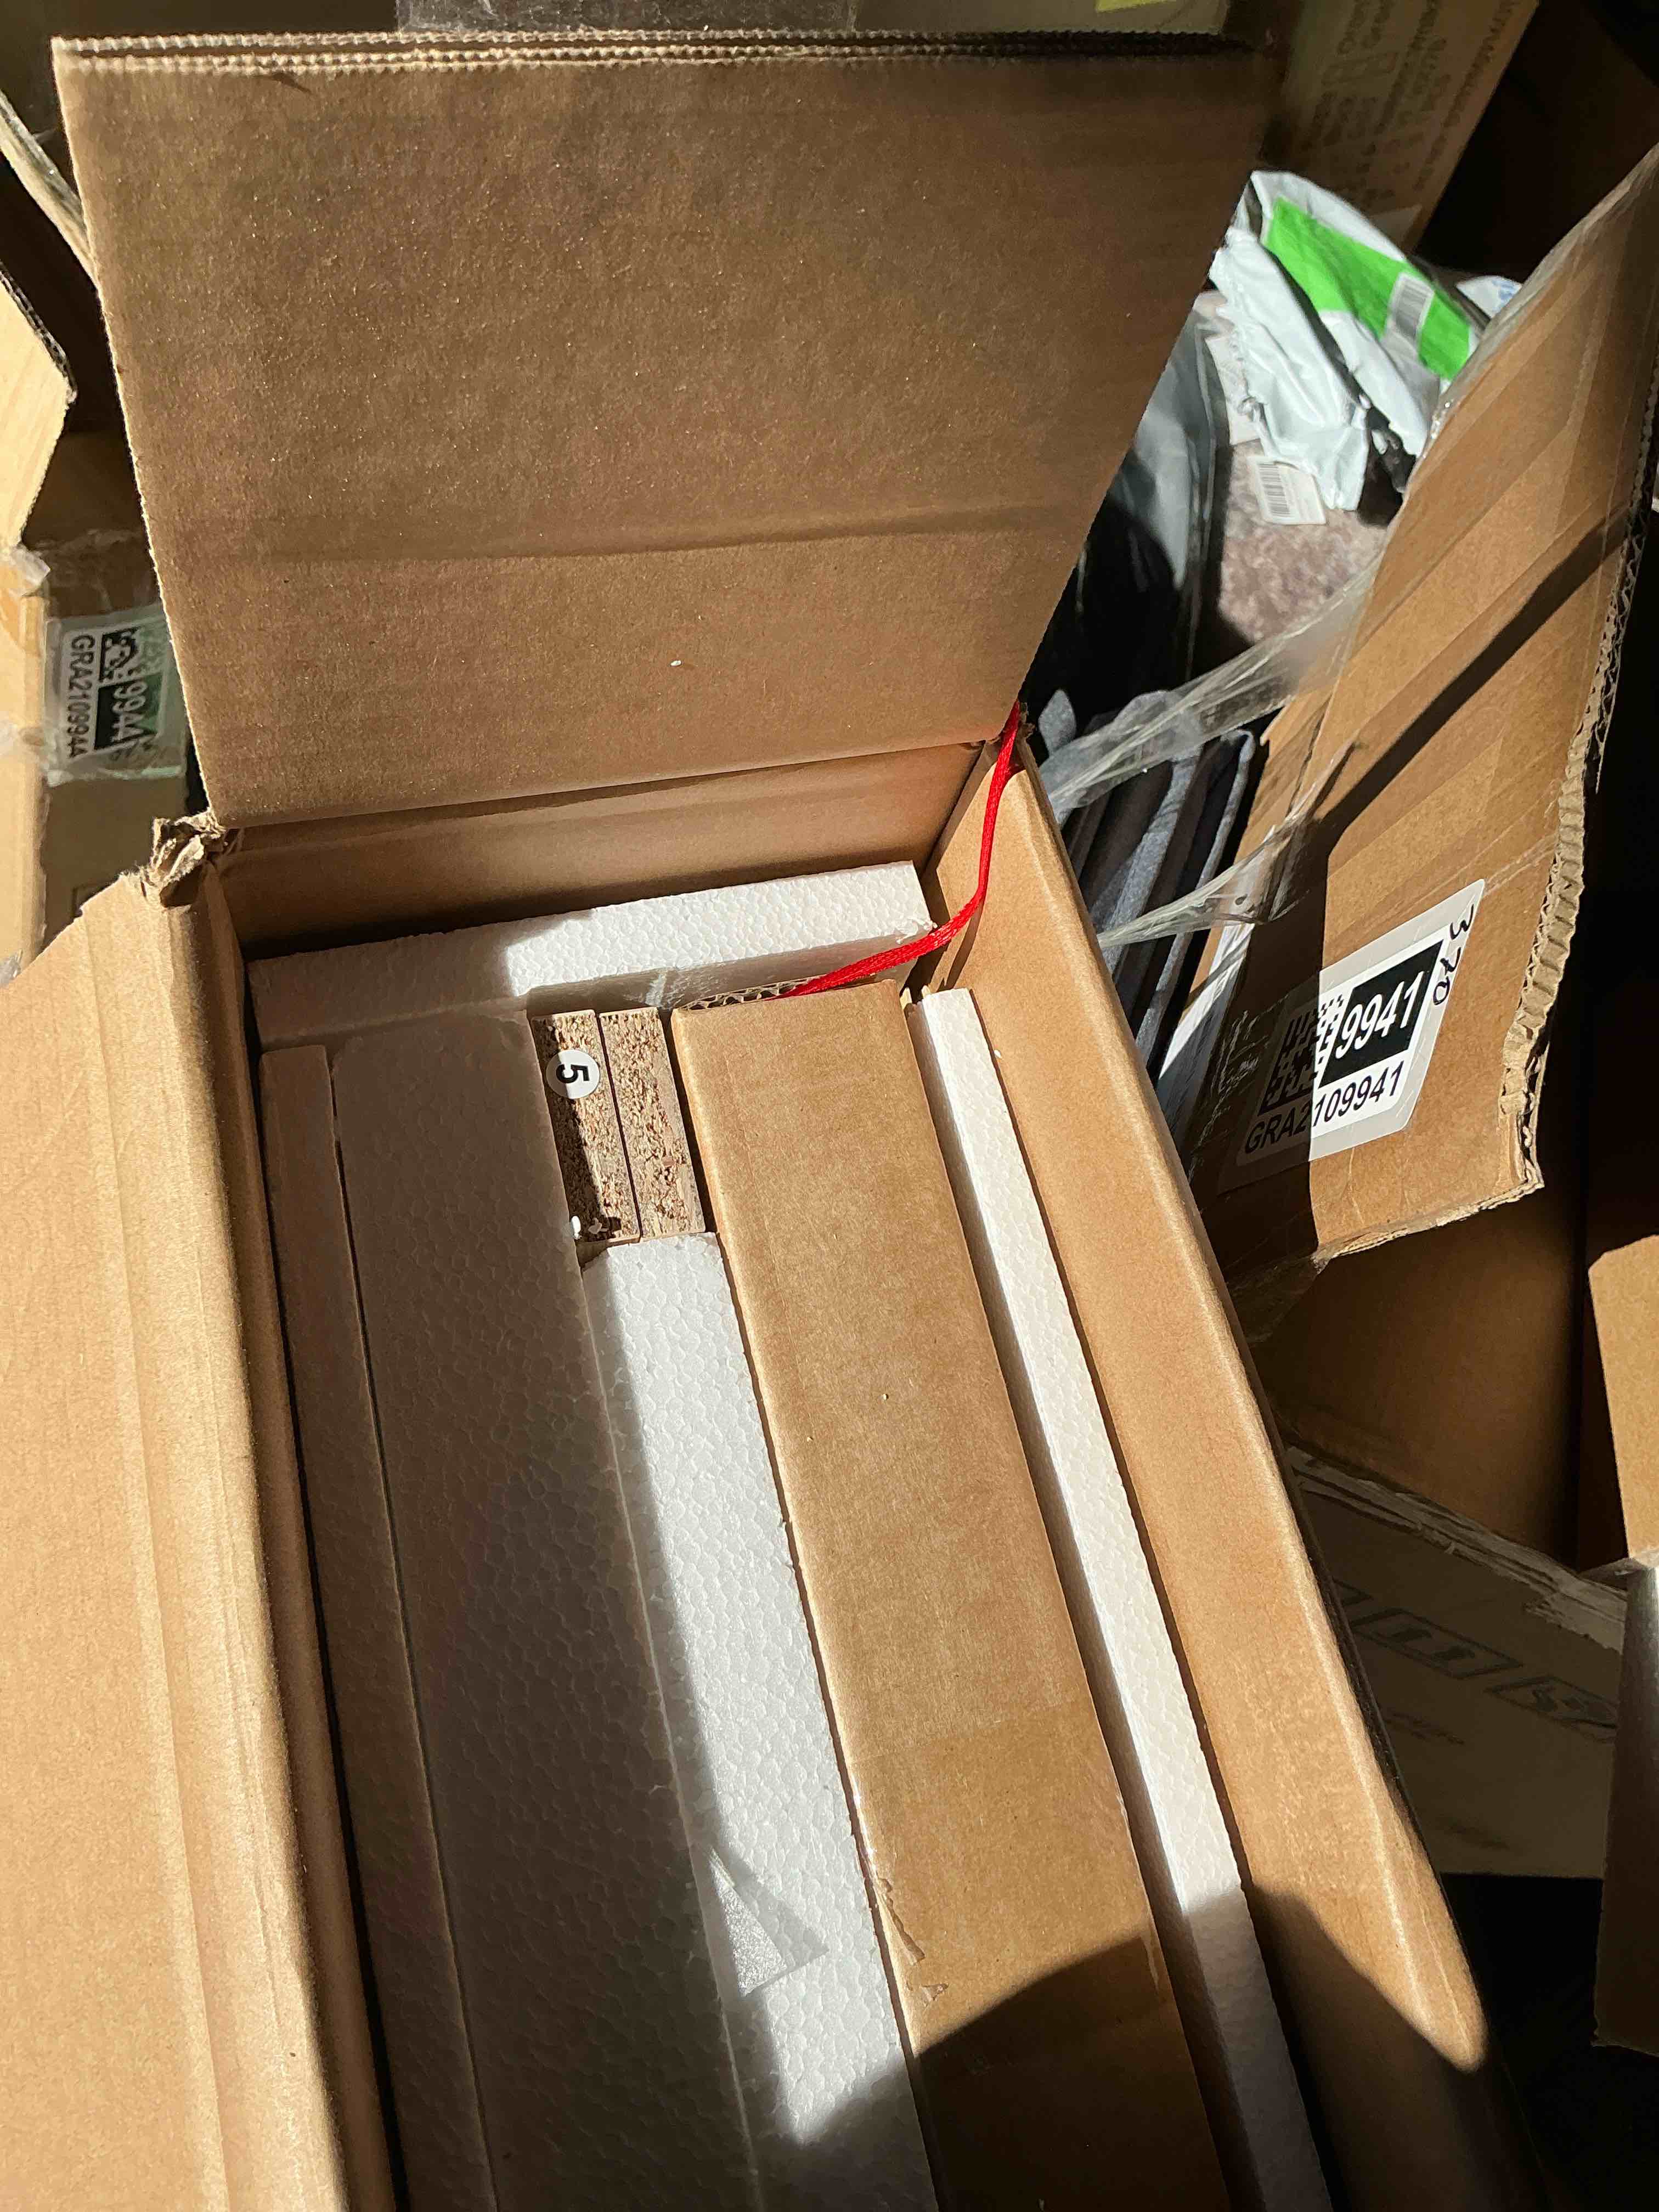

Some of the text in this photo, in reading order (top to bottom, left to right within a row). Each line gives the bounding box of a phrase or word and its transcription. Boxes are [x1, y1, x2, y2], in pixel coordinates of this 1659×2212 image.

[67, 634, 95, 758] GRA2109944
[1336, 971, 1424, 1059] 9941
[555, 1064, 590, 1084] 5
[1245, 1061, 1404, 1154] GRA2109941
